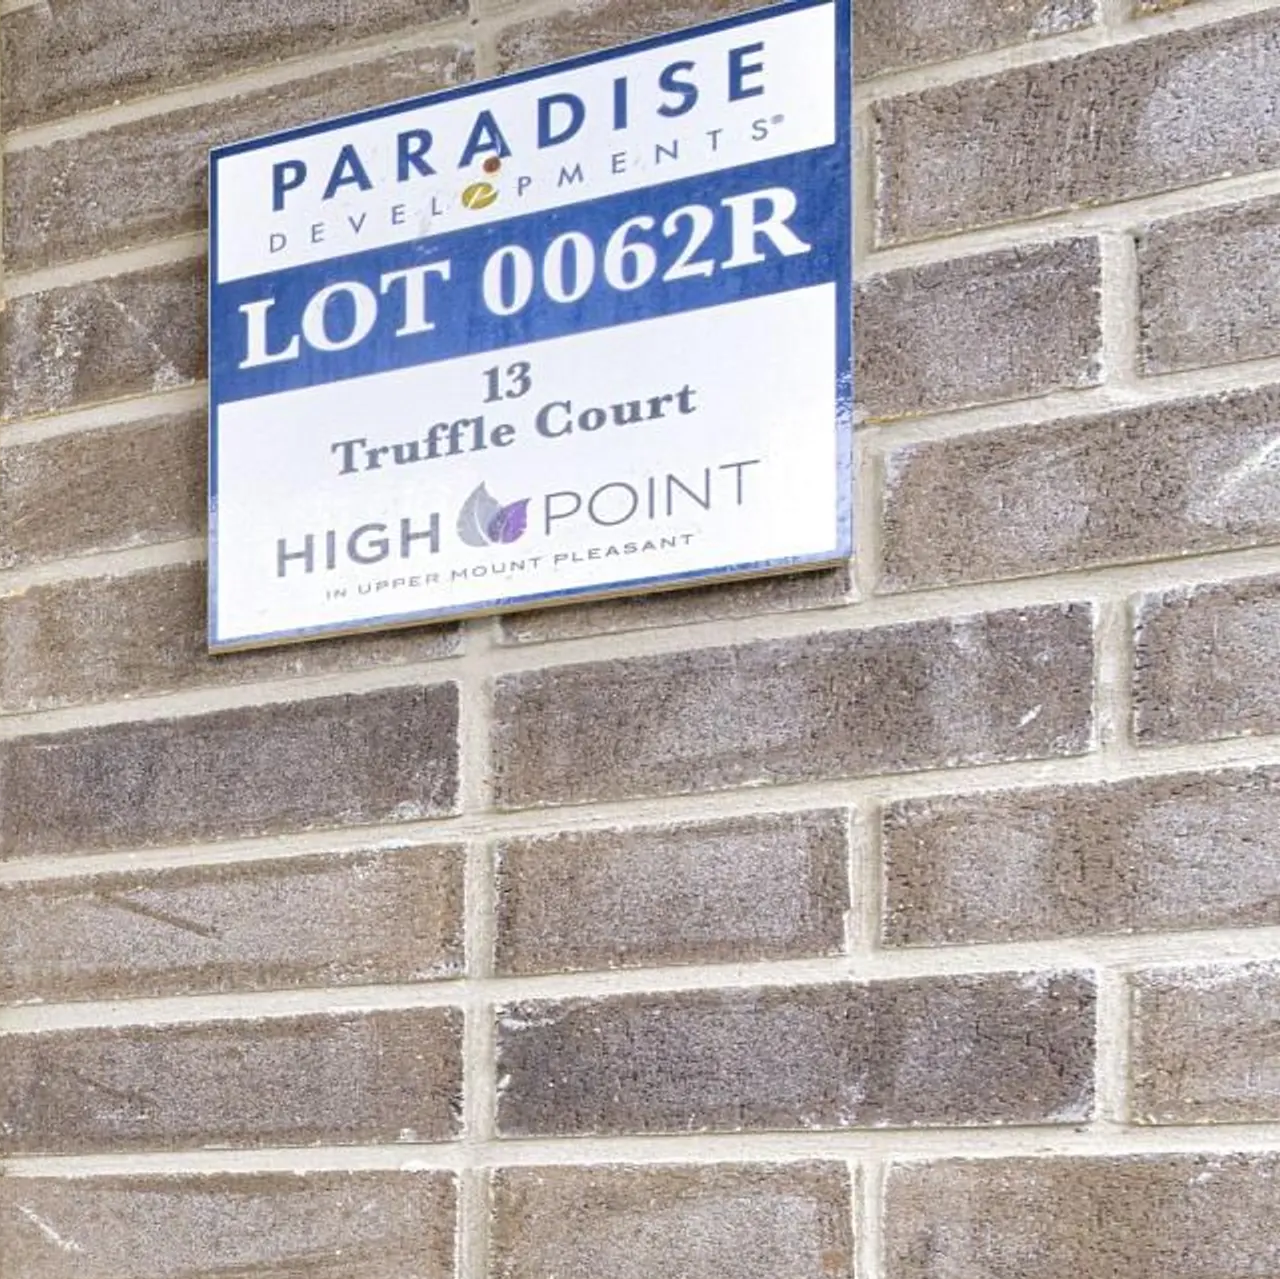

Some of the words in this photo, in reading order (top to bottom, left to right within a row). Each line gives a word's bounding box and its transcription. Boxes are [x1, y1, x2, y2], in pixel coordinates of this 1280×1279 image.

[272, 42, 765, 211] PARADISE
[239, 260, 450, 370] LOT
[482, 186, 812, 317] 0062R
[331, 416, 516, 476] Truffle
[535, 384, 697, 439] Court
[482, 361, 532, 404] 13
[275, 512, 441, 578] HIGH
[543, 459, 761, 537] POINT
[326, 588, 348, 601] IN
[357, 572, 440, 597] UPPER
[450, 557, 542, 582] MOUNT
[553, 534, 696, 567] PLEASANT
